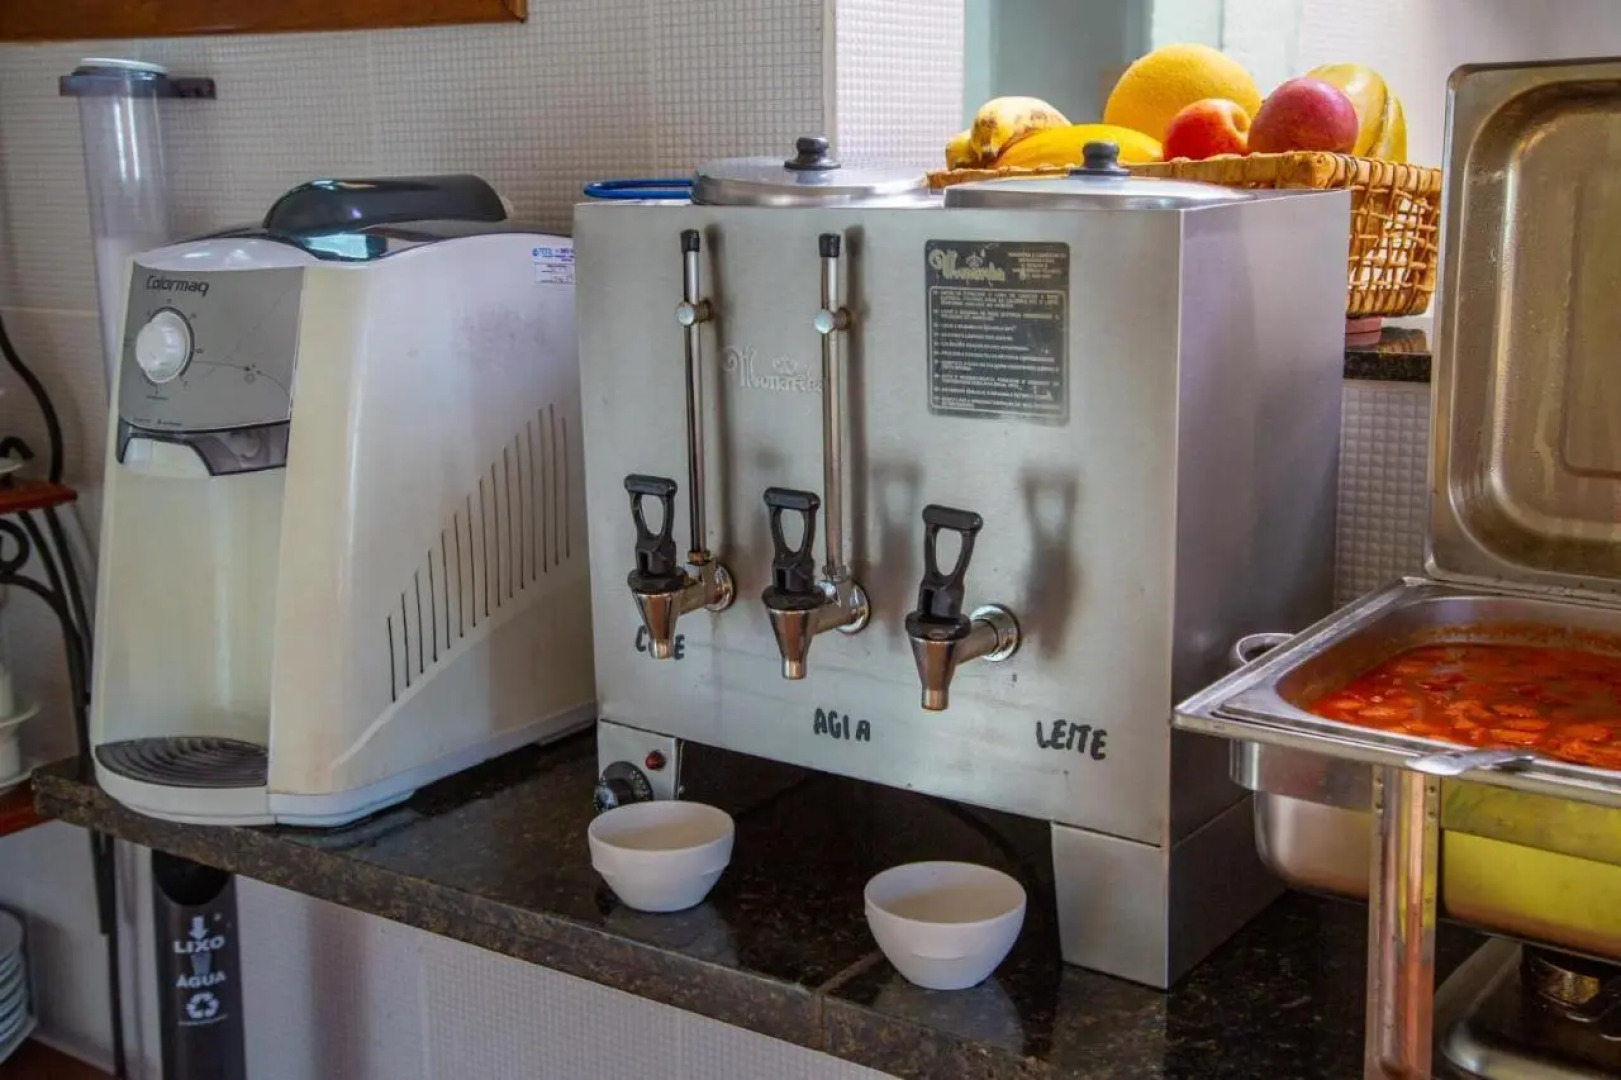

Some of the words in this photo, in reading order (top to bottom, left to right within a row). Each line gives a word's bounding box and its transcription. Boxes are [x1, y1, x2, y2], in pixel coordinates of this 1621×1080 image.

[146, 274, 209, 297] Colormaq
[635, 625, 685, 660] CE
[1036, 719, 1108, 760] LEITE
[174, 936, 225, 953] LIXO
